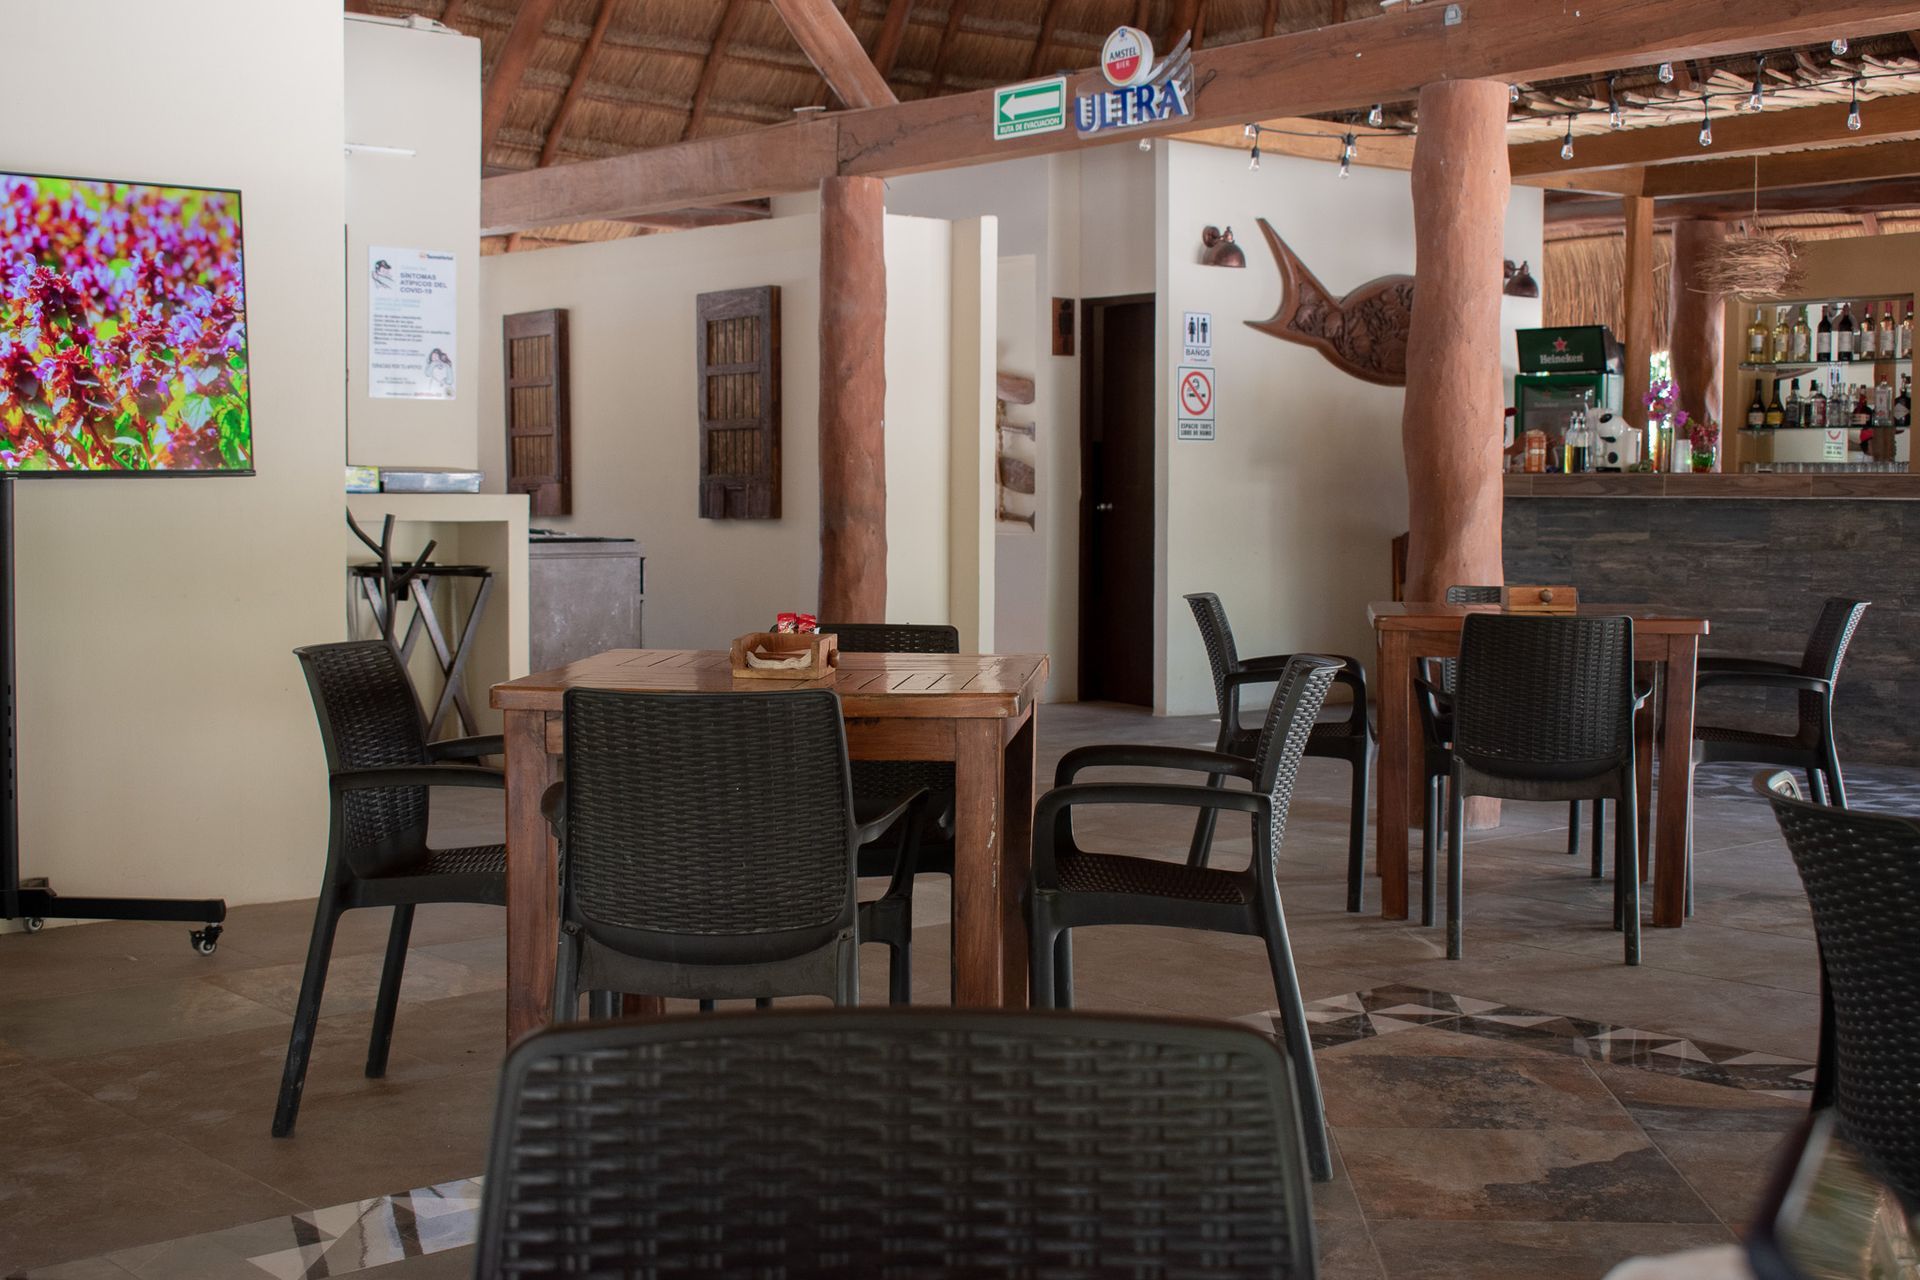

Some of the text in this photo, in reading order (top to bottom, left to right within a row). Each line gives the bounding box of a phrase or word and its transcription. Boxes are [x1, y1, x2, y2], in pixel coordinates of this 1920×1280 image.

[1109, 46, 1137, 61] AMSTEL
[1115, 60, 1131, 70] BIER
[1075, 79, 1188, 132] ULTRA
[1000, 125, 1014, 134] RUTA
[1015, 123, 1022, 131] DE
[1540, 353, 1584, 365] Heineken
